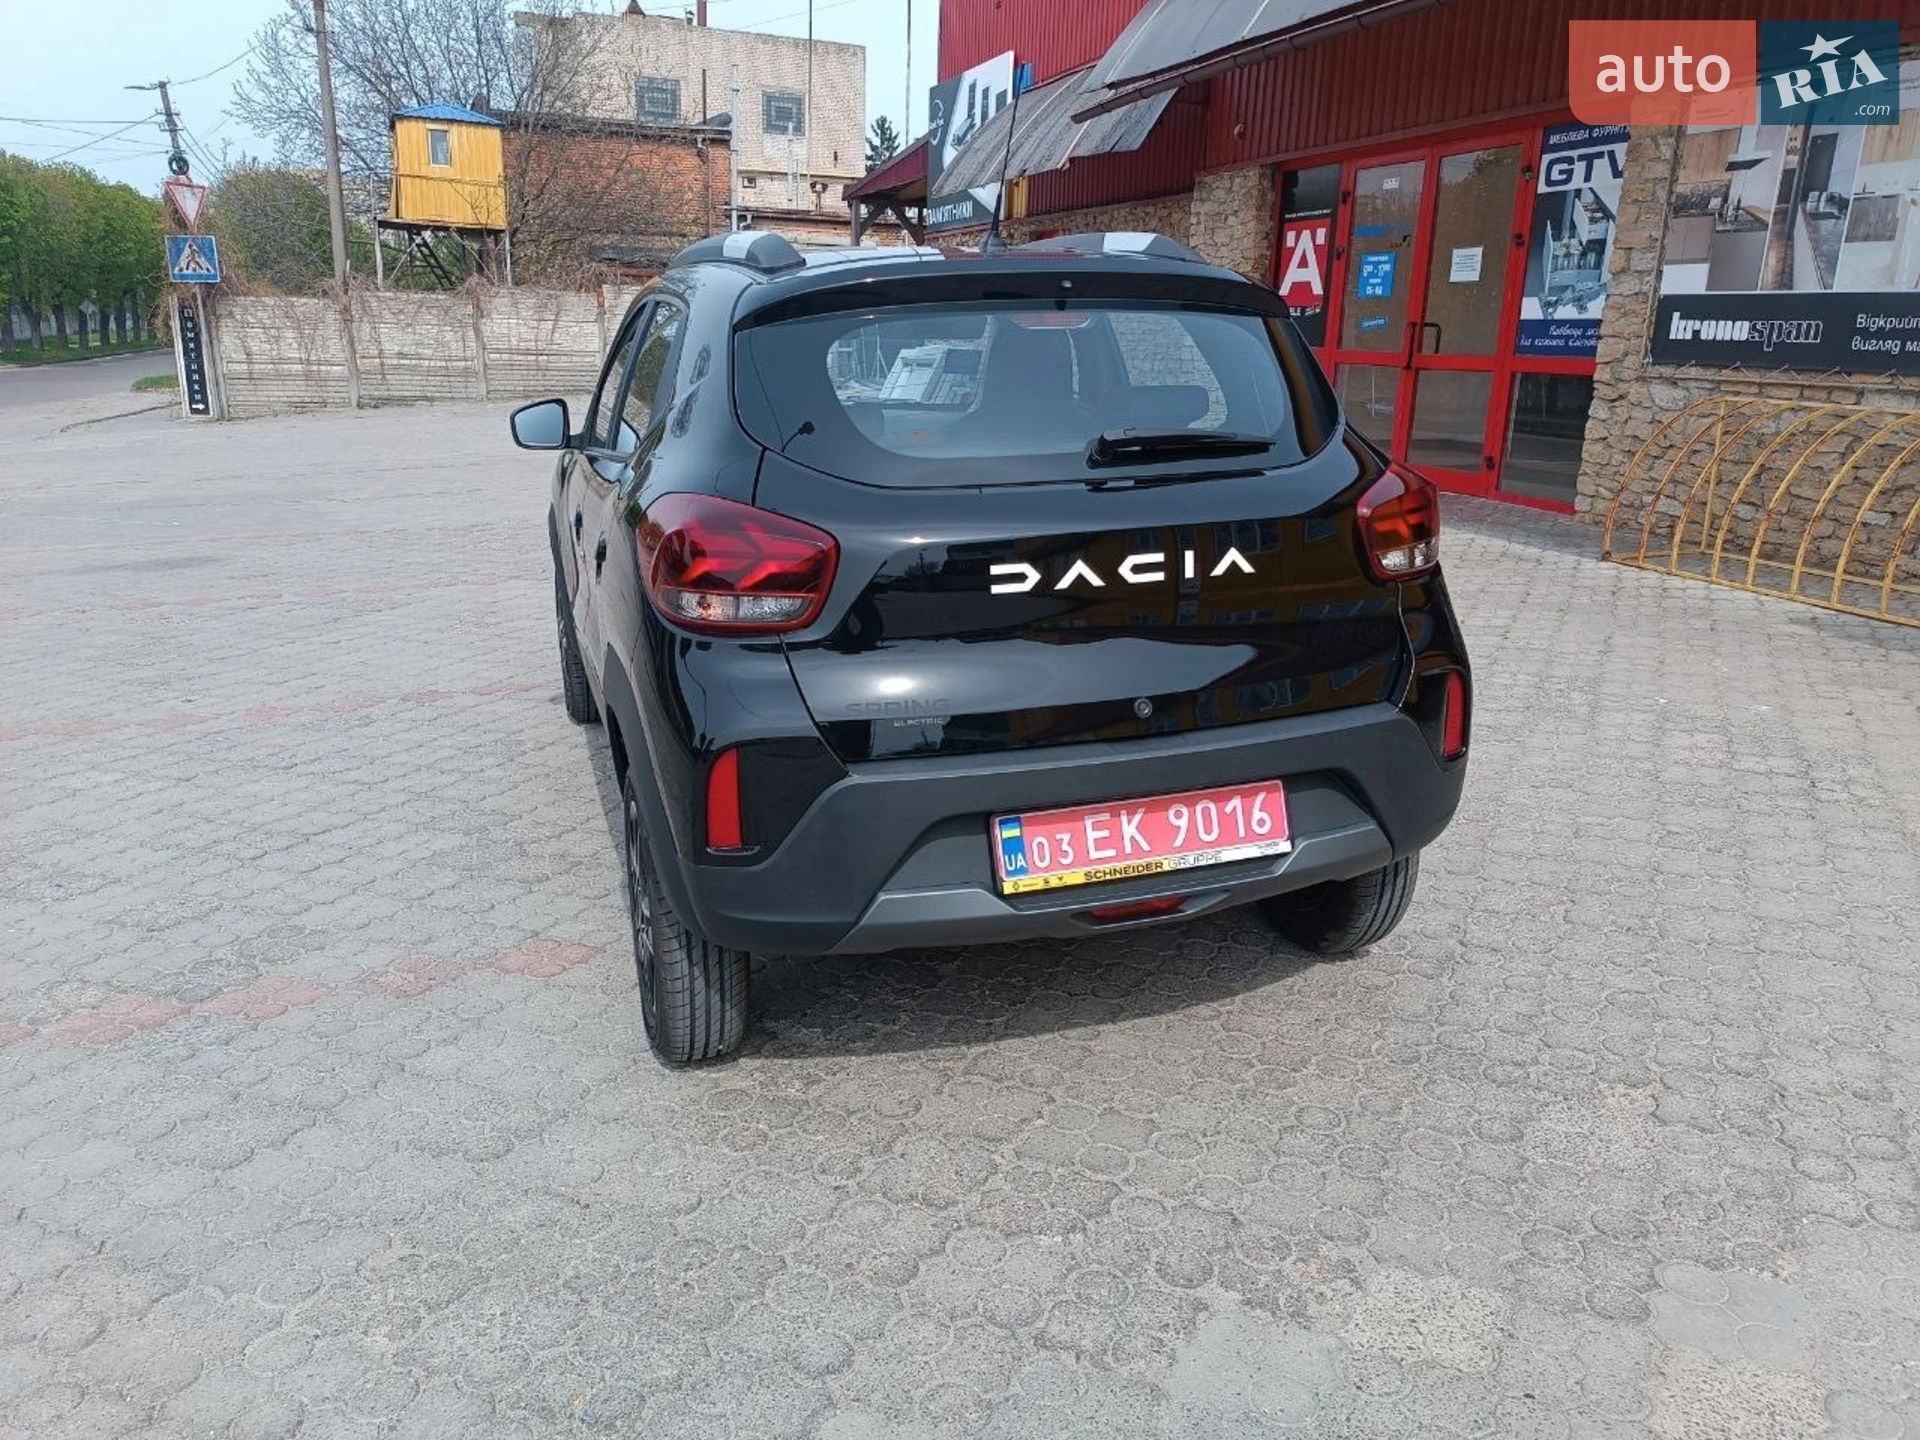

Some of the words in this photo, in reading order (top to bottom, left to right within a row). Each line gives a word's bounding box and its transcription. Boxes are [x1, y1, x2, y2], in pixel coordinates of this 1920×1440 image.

[1668, 311, 1824, 351] kronospan
[1852, 335, 1901, 355] вигляд
[989, 547, 1256, 595] DACIA
[1031, 832, 1075, 869] 03
[1084, 809, 1151, 861] EK
[1167, 792, 1273, 848] 9016
[1004, 853, 1028, 871] UA
[1083, 861, 1164, 882] SCHNEIDER
[1167, 852, 1223, 870] GRUPPE
